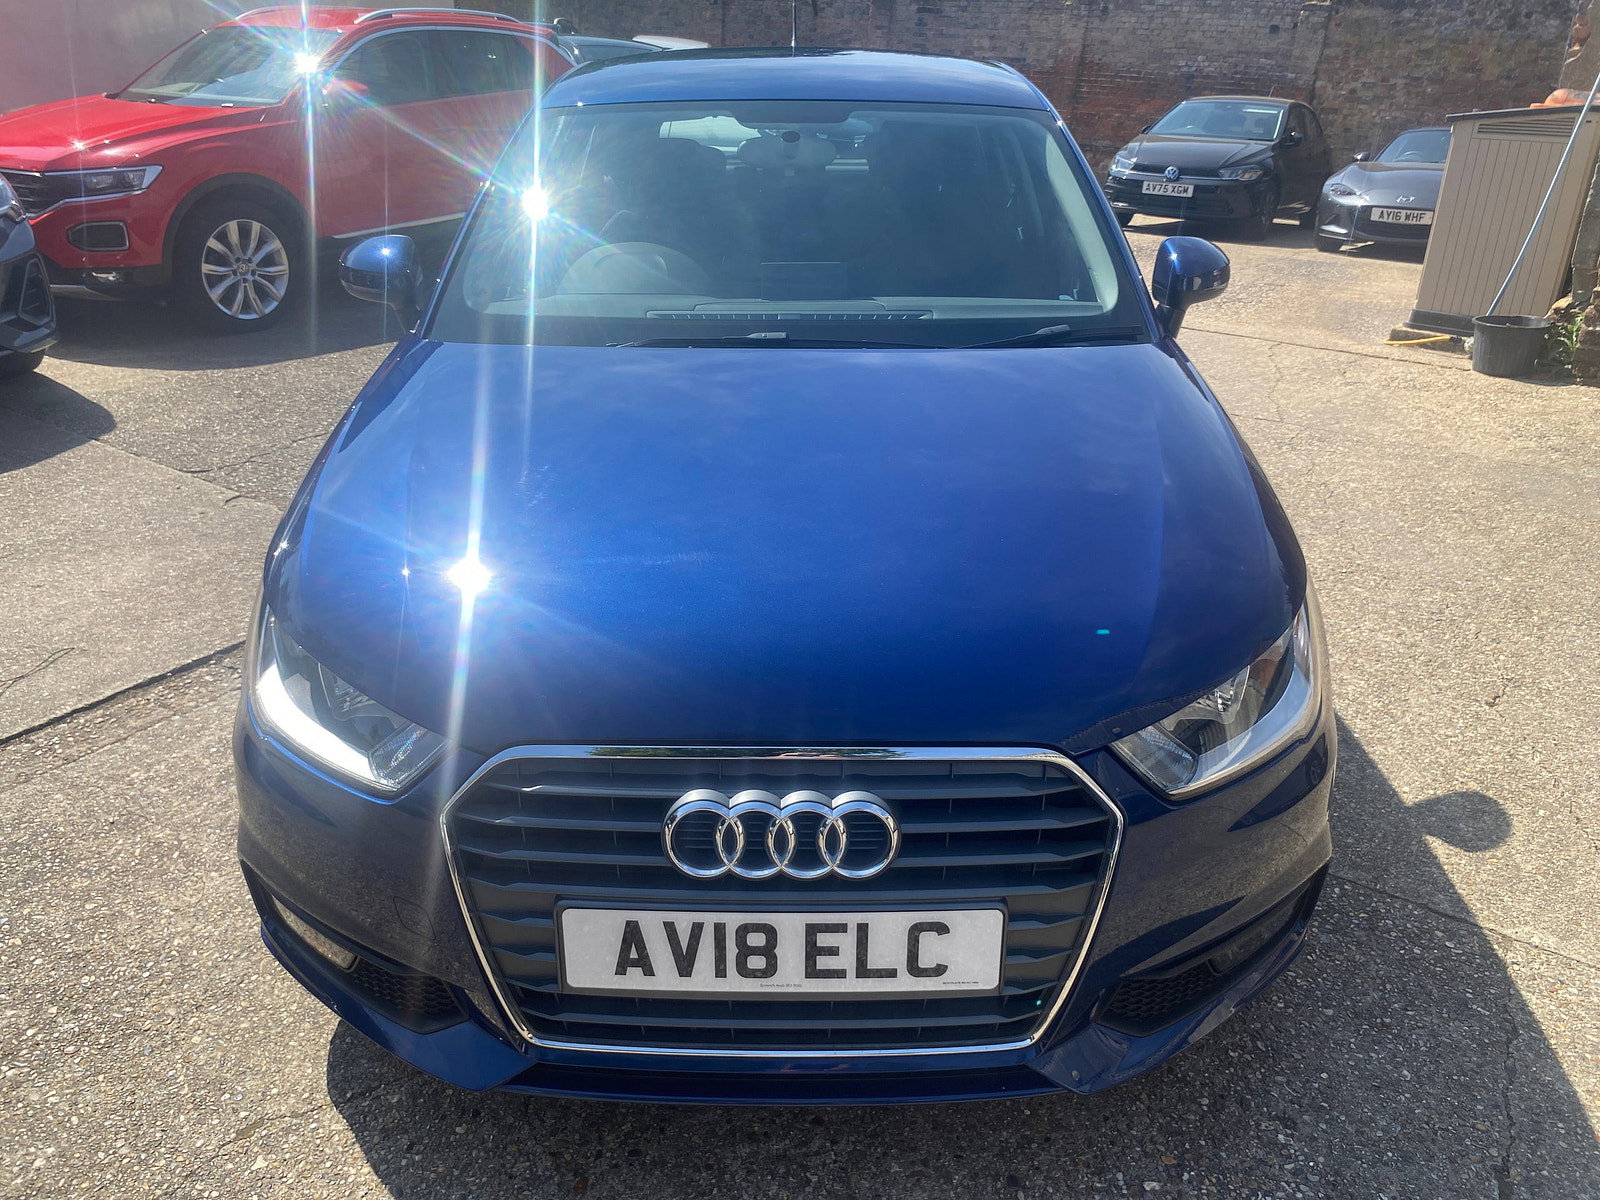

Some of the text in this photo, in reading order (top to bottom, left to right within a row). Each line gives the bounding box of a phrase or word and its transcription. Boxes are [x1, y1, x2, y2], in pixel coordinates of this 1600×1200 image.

[1145, 183, 1189, 195] AV75 XGM
[1378, 210, 1426, 222] AY16 WHF
[614, 920, 951, 979] AV18 ELC
